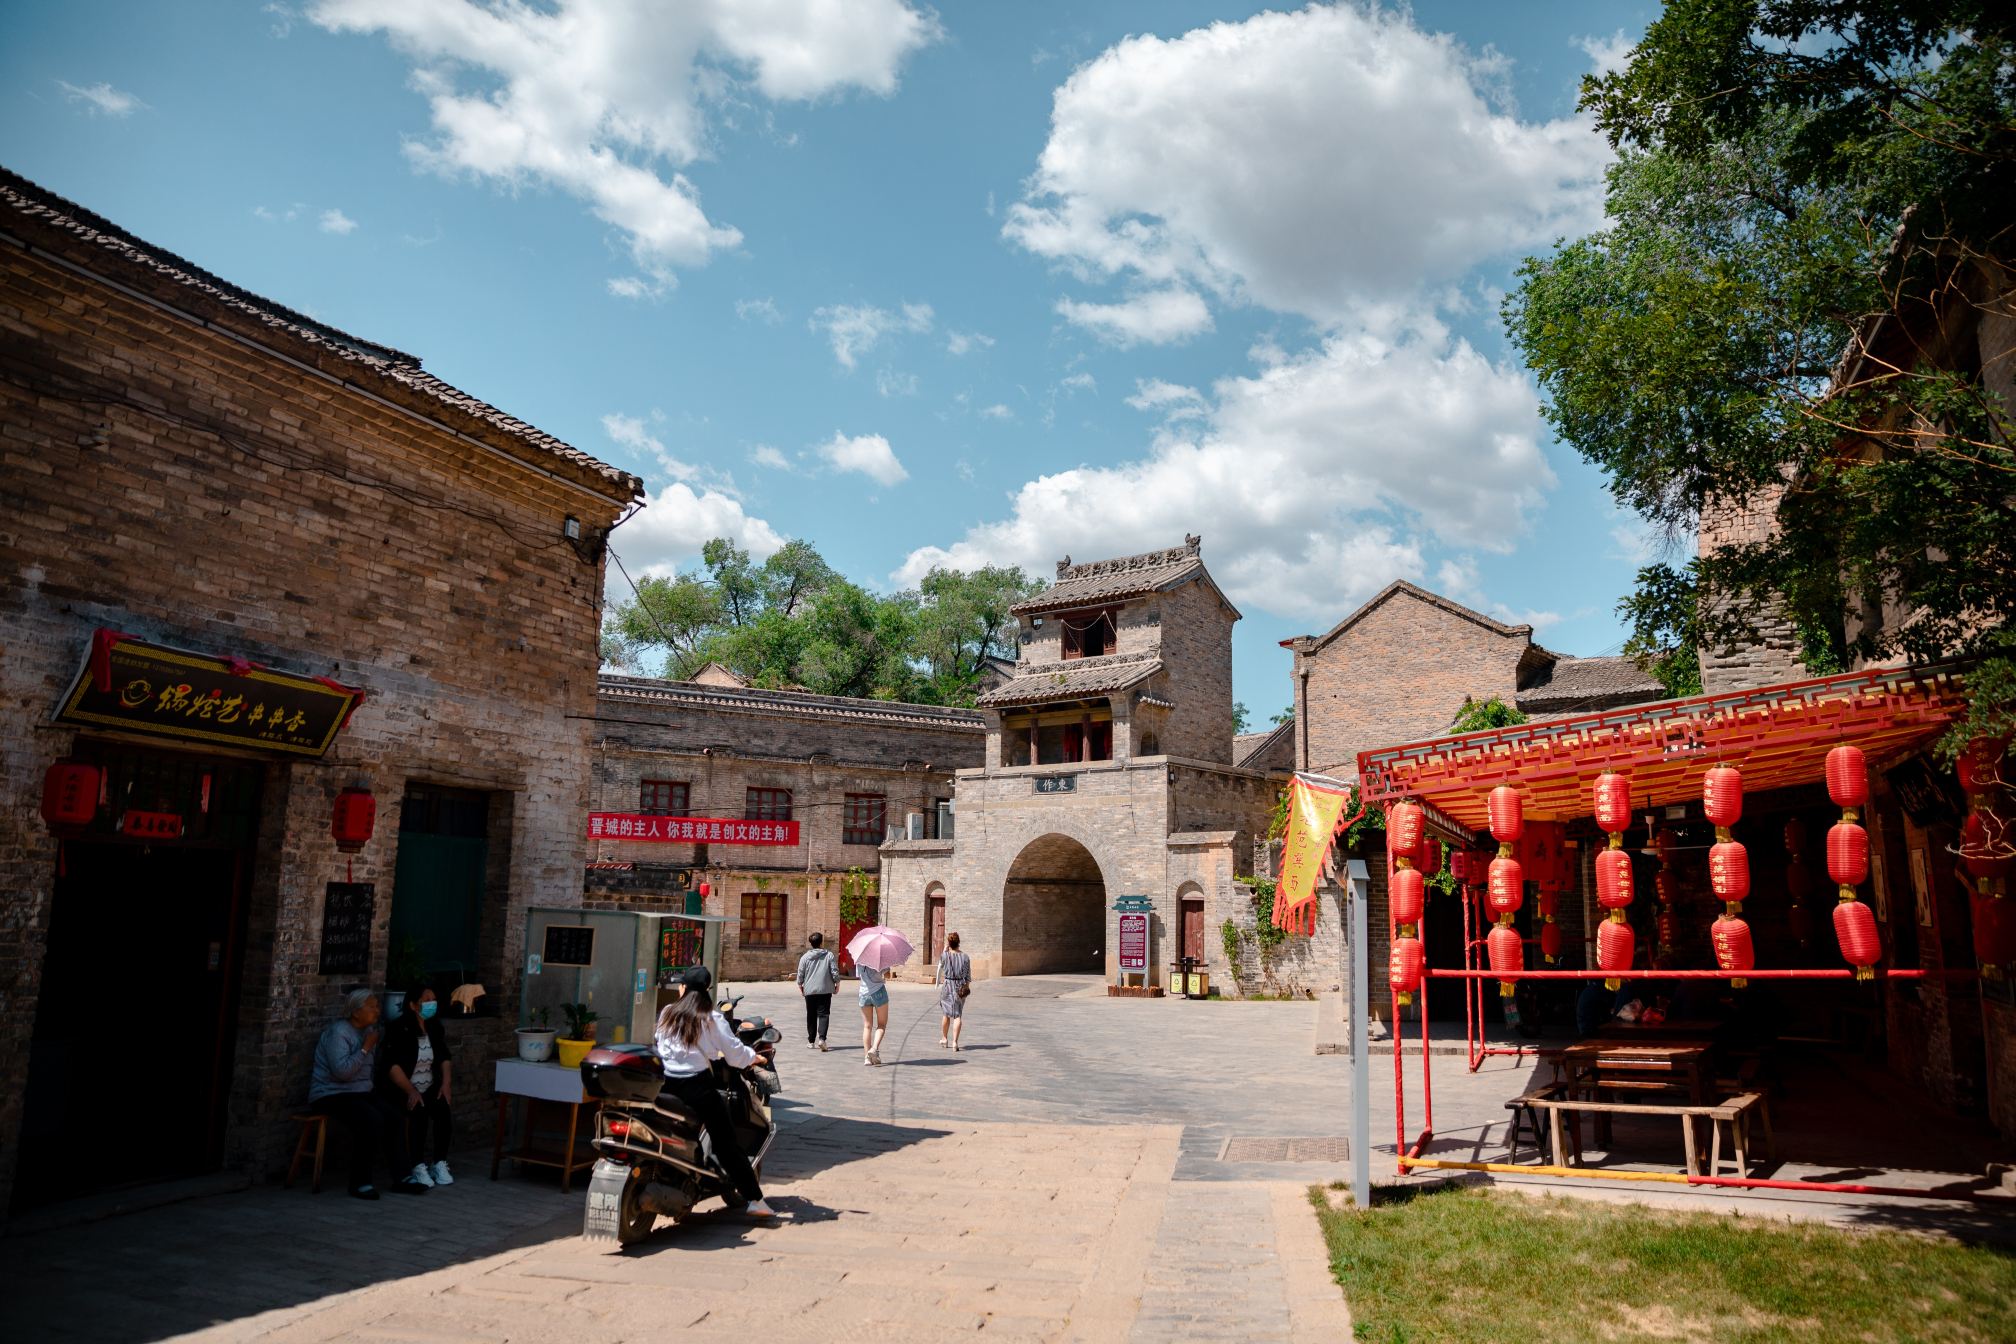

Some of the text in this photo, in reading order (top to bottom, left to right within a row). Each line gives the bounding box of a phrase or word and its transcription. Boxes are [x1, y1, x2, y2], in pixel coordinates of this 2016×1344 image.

[591, 817, 789, 842] 晋城的主人 你我就是创文的主角!
